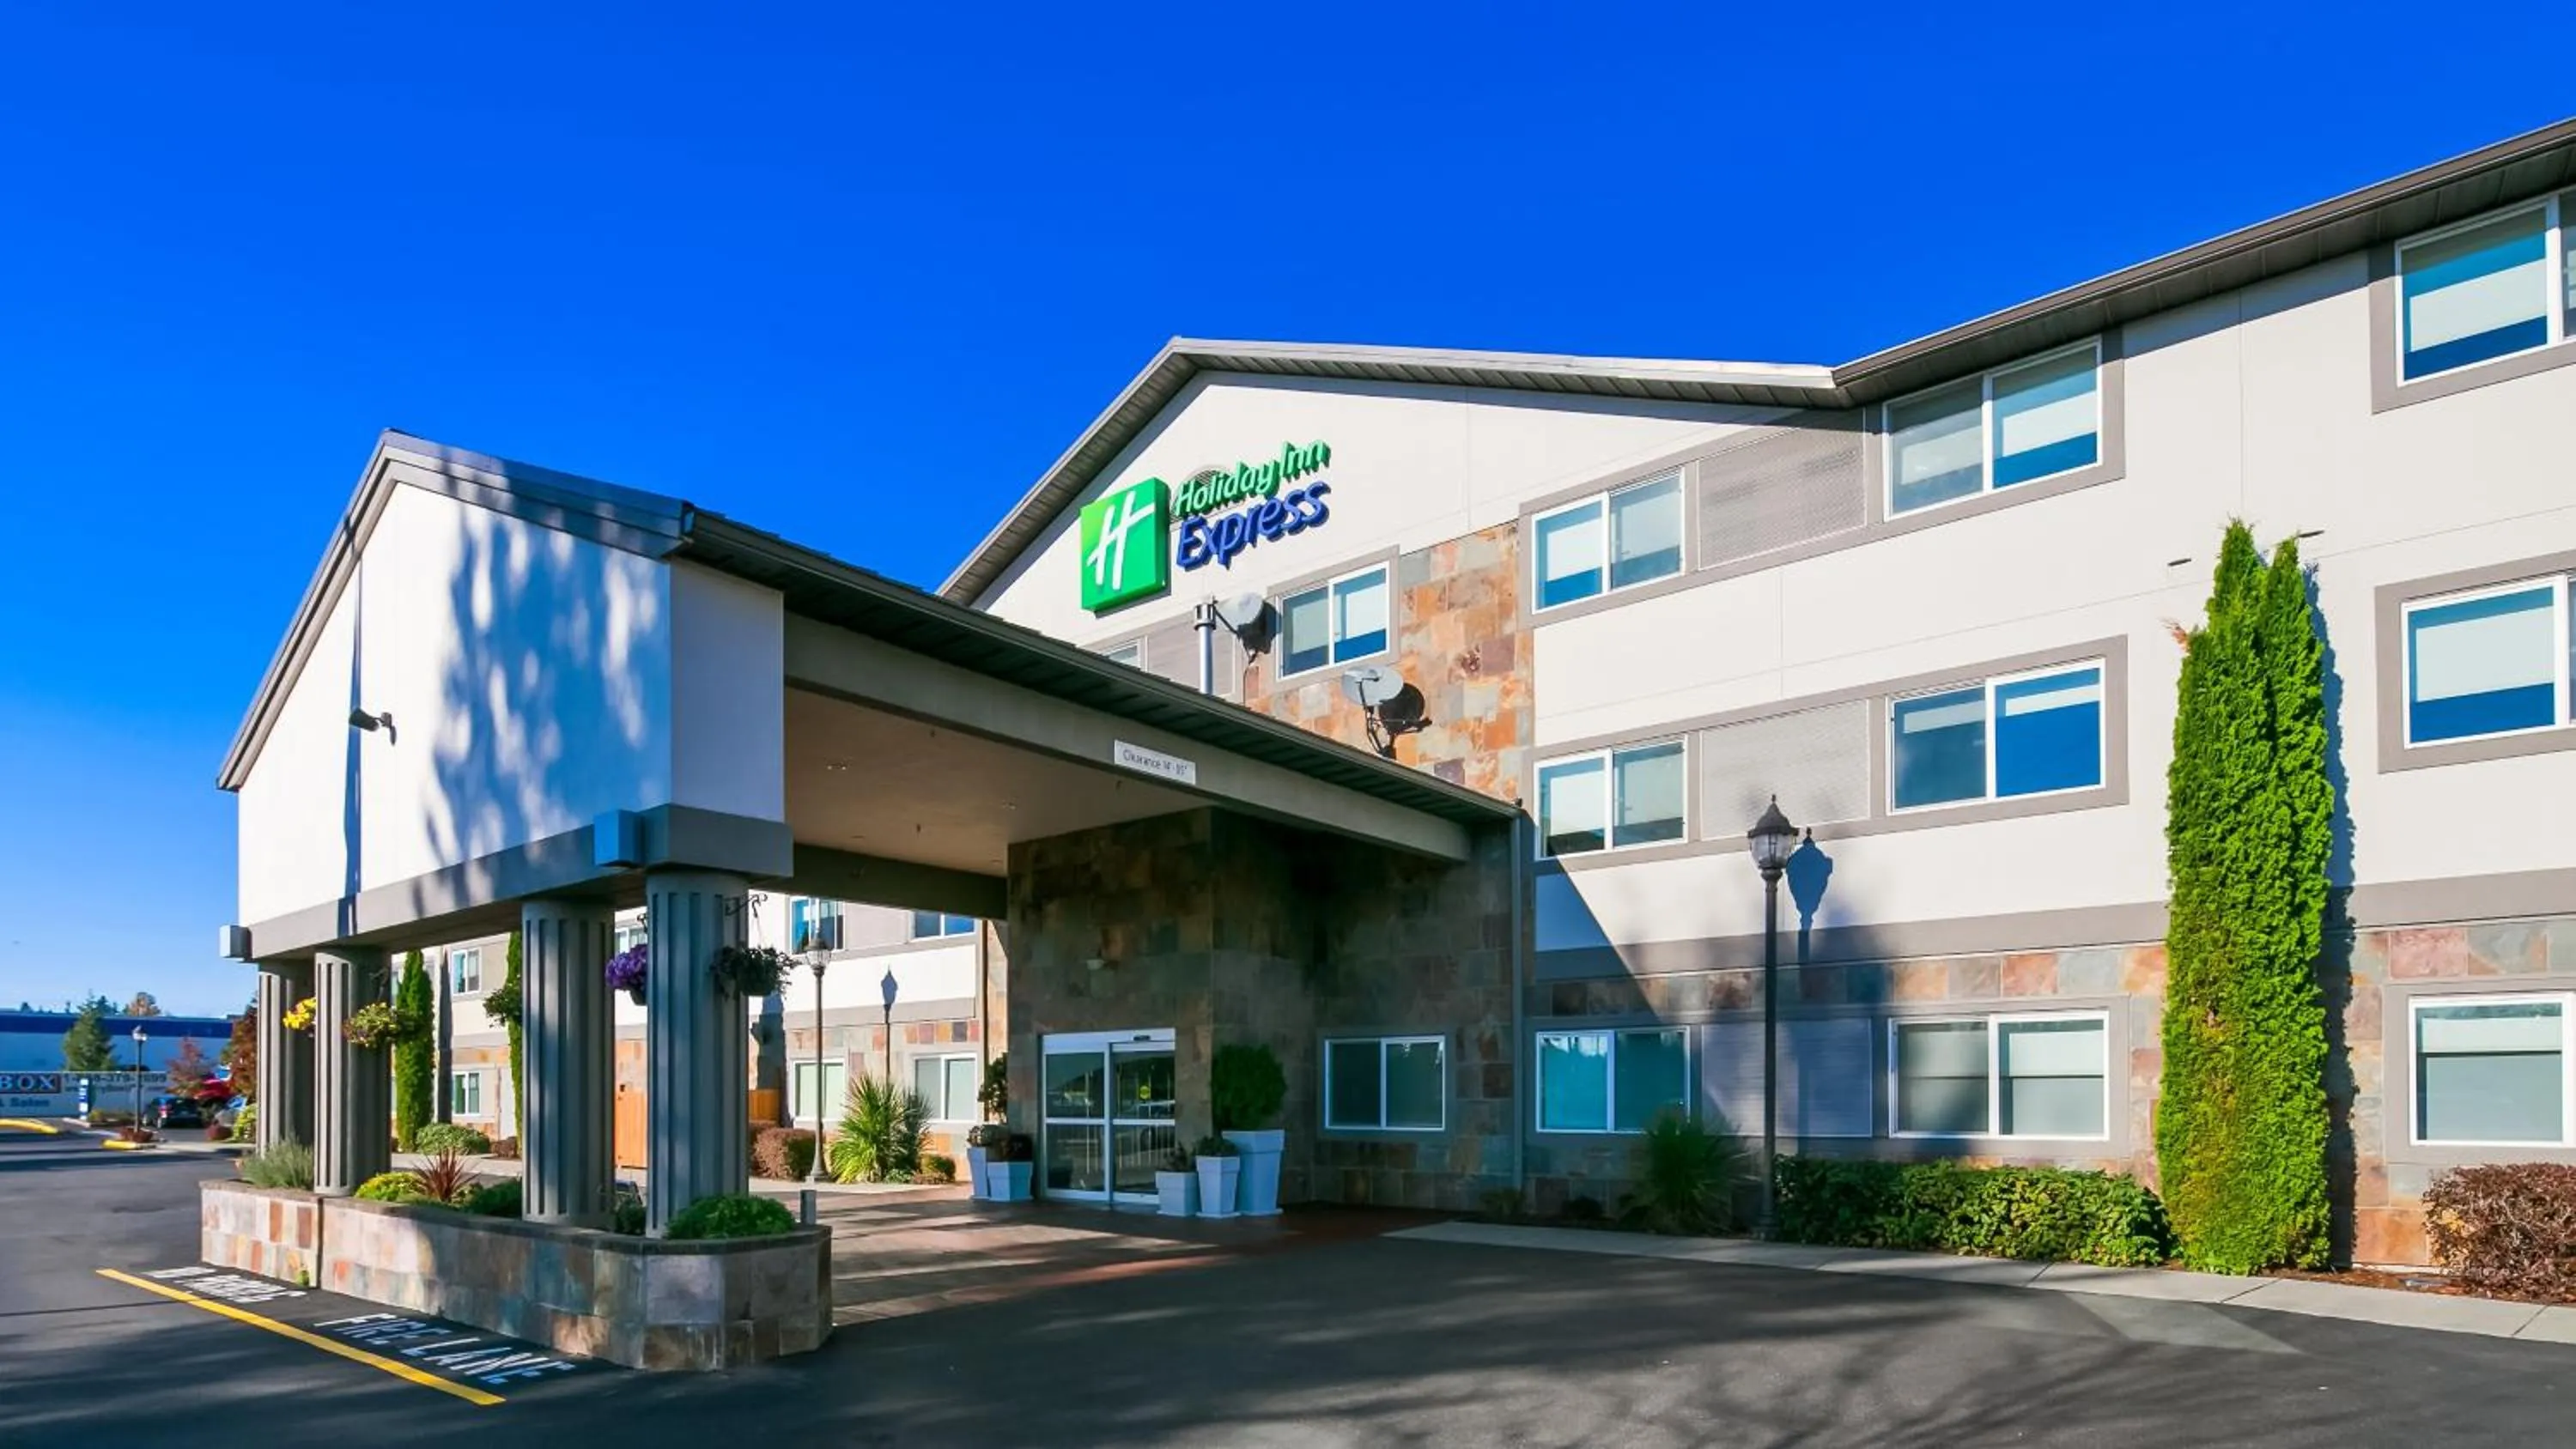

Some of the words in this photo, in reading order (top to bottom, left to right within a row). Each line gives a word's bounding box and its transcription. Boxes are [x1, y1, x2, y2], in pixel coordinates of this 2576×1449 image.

[1175, 460, 1279, 518] Holiday
[1279, 439, 1331, 482] Inn
[1176, 480, 1332, 572] Express
[399, 1337, 576, 1385] LANE
